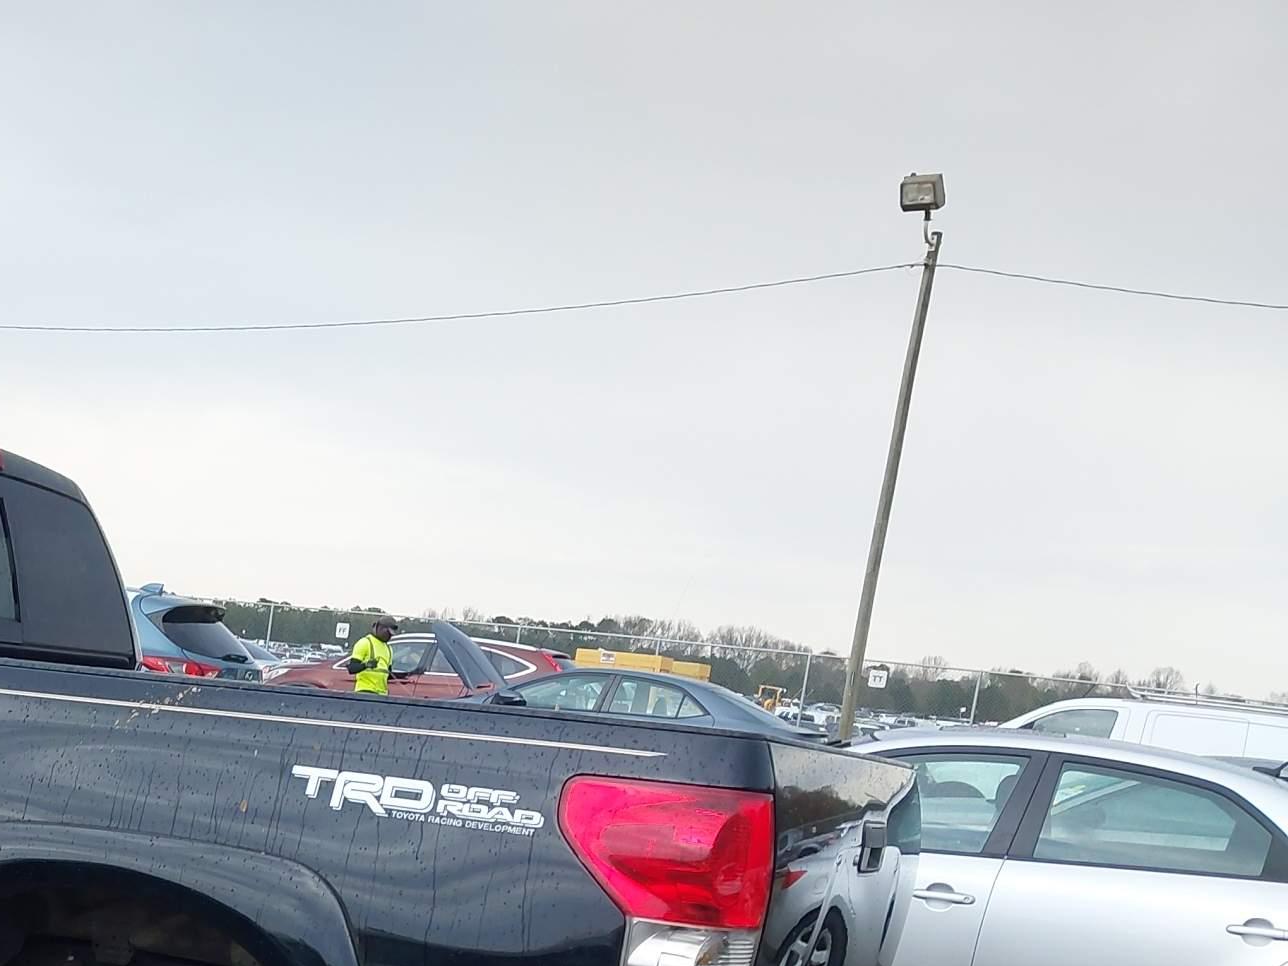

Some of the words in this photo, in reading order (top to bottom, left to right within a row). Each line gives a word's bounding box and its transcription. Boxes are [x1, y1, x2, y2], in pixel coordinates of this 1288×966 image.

[291, 765, 436, 817] TRD
[391, 811, 425, 822] TOYOTA
[427, 815, 463, 827] RACING
[465, 821, 536, 837] DEVELOPMENT
[436, 799, 545, 829] ROAD
